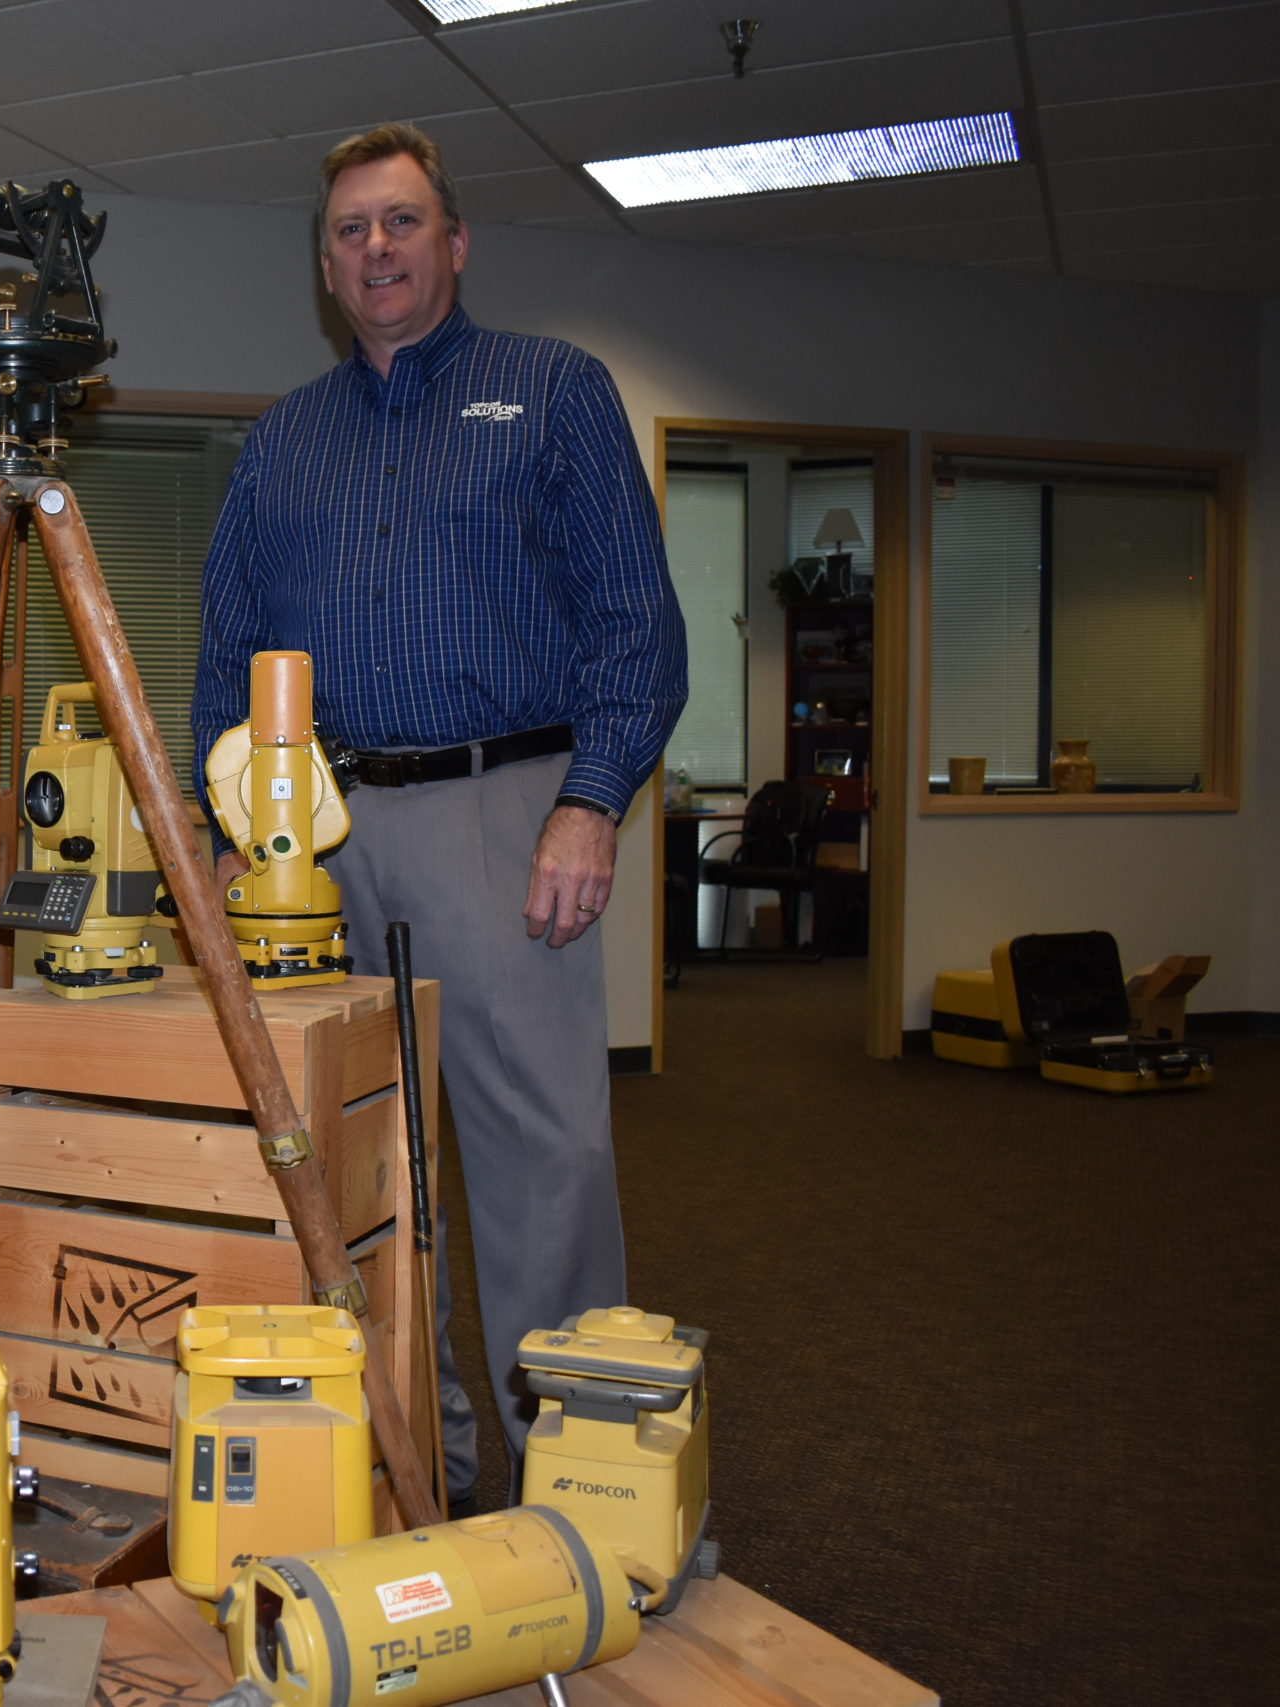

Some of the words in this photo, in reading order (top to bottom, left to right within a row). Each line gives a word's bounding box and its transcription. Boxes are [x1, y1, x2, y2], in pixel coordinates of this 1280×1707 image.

[461, 405, 524, 417] SOLUTIONS
[470, 401, 501, 409] TOPCON
[574, 1481, 637, 1501] TOPCON
[277, 1566, 301, 1590] BEAM
[388, 1607, 410, 1619] RENTAL
[411, 1598, 449, 1613] DEPARTMENT
[524, 1615, 569, 1634] TOPCON
[370, 1624, 472, 1671] TP-L2B
